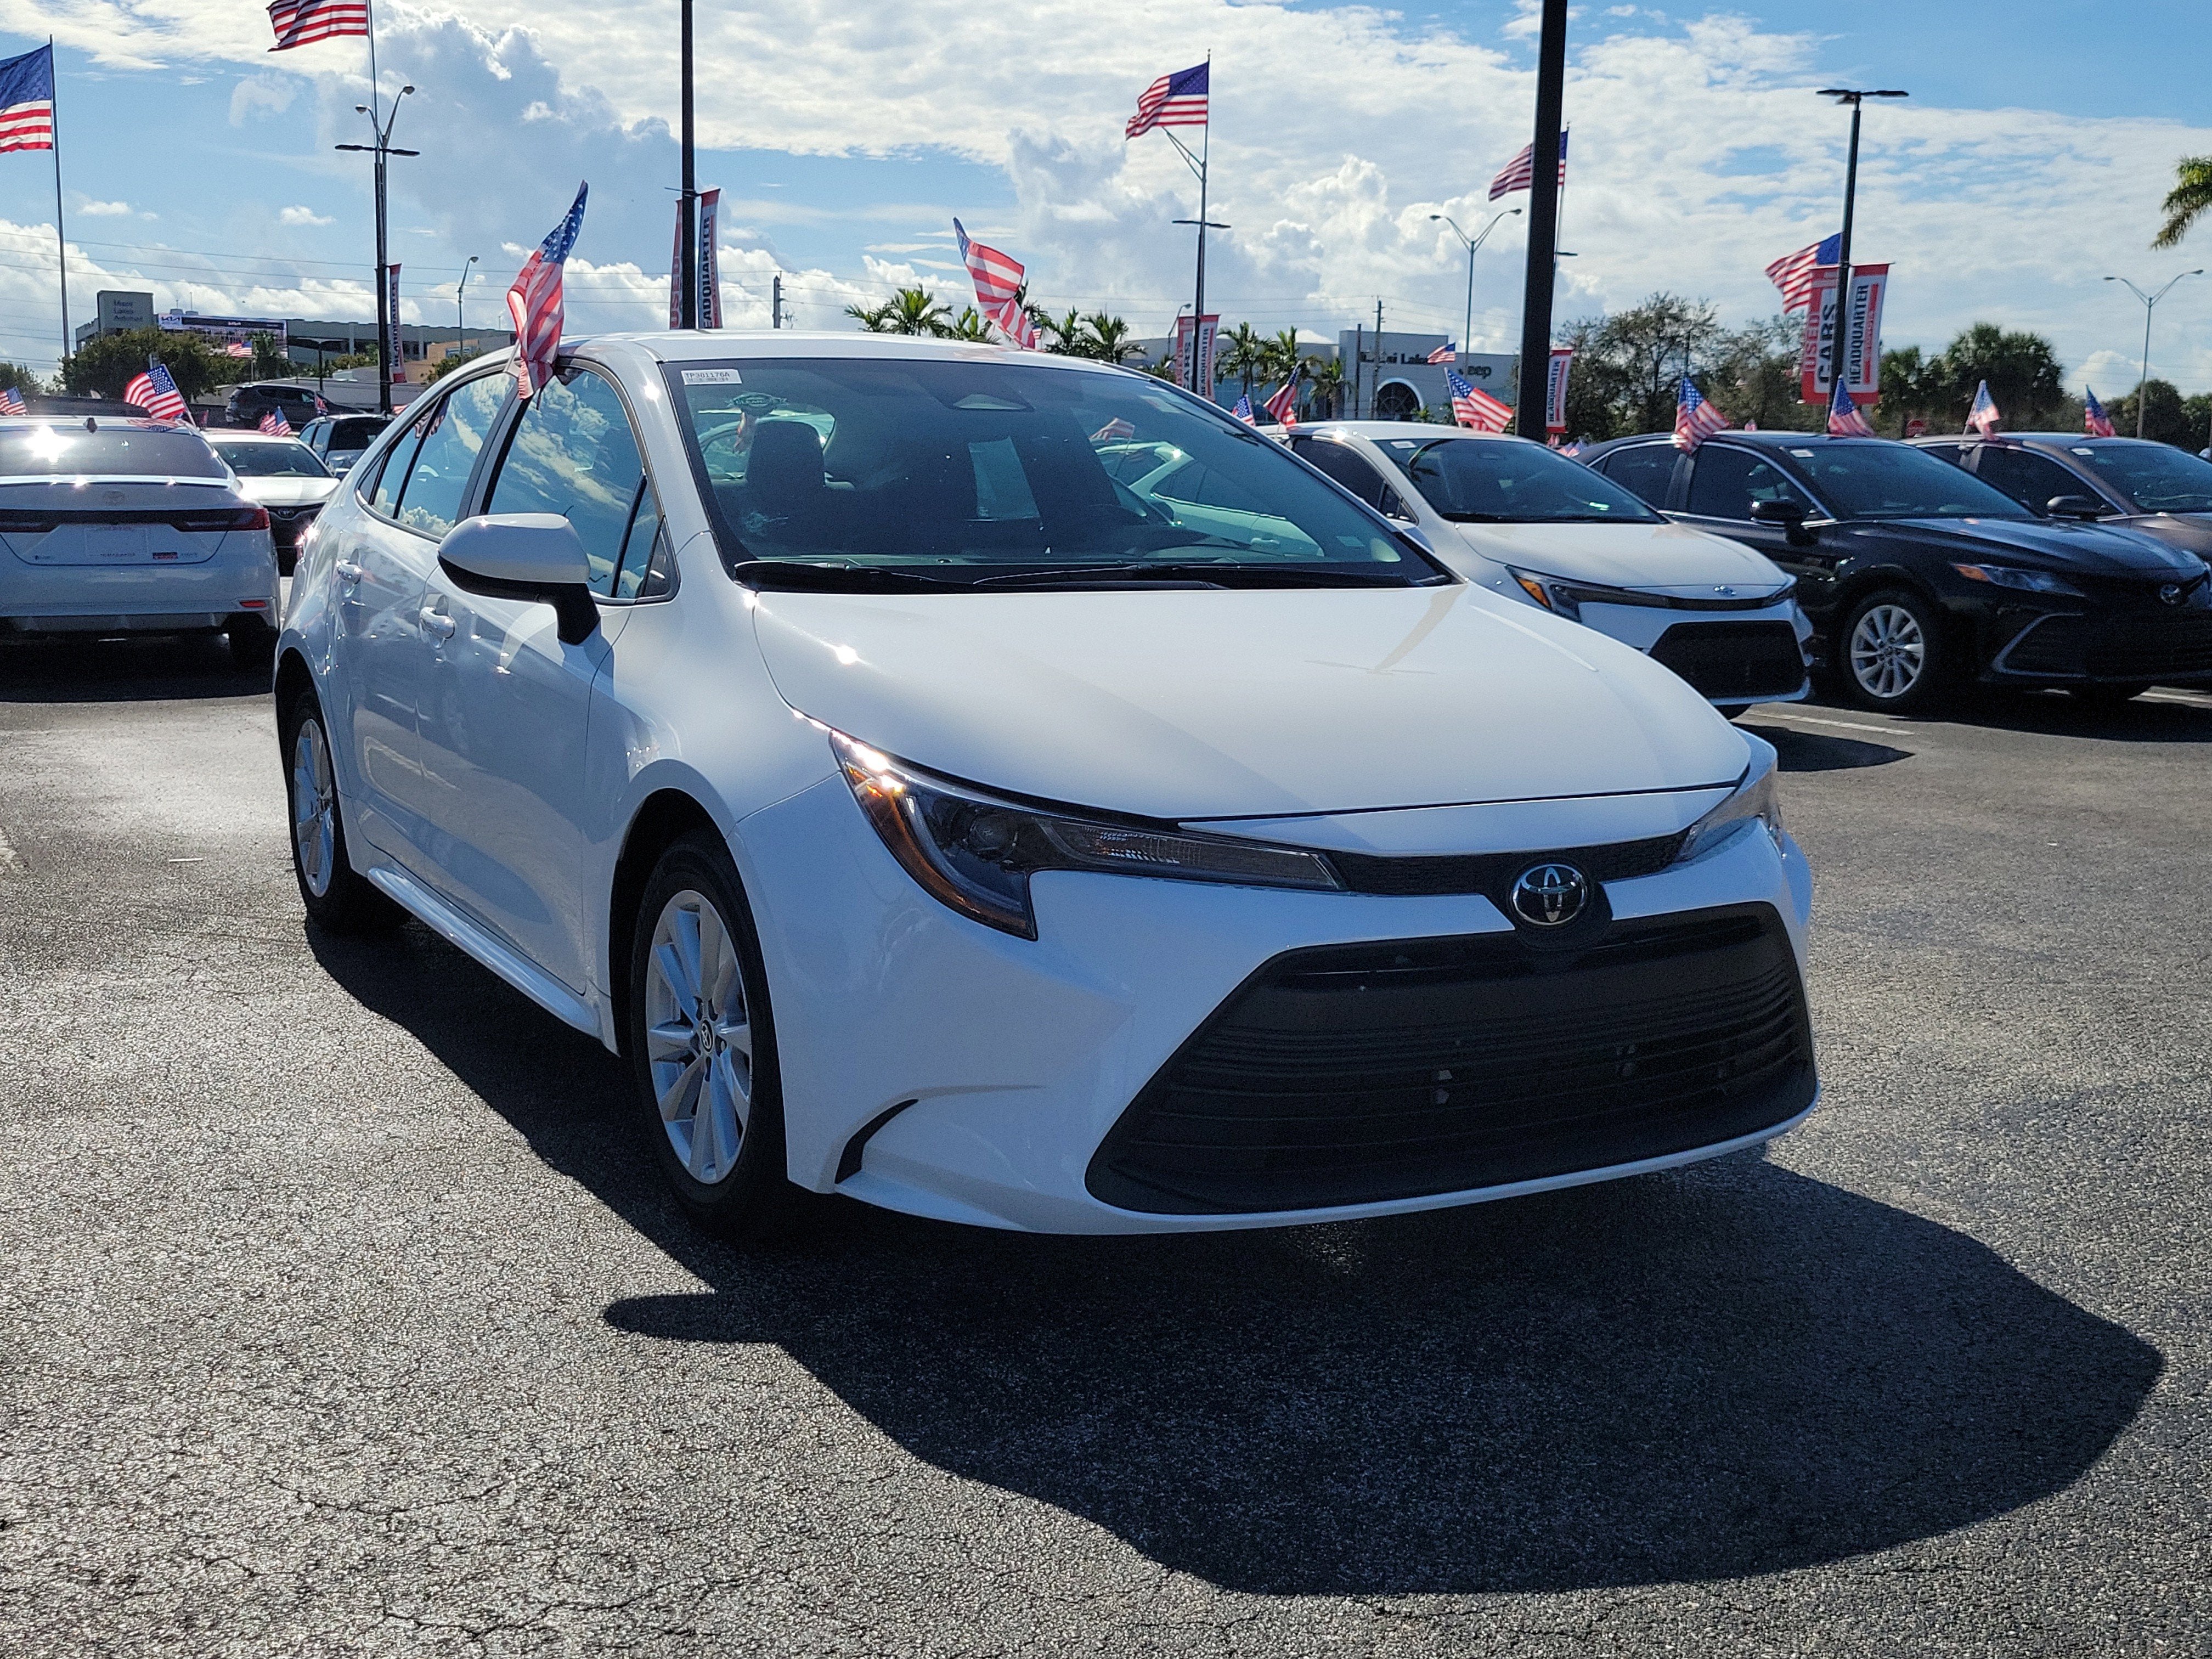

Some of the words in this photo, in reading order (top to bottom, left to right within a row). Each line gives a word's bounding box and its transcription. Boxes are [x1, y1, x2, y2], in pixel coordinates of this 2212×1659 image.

[702, 217, 712, 329] EADQUARTER
[1803, 313, 1819, 371] USED
[1817, 304, 1836, 383] CARS
[1849, 285, 1869, 385] HEADQUARTER
